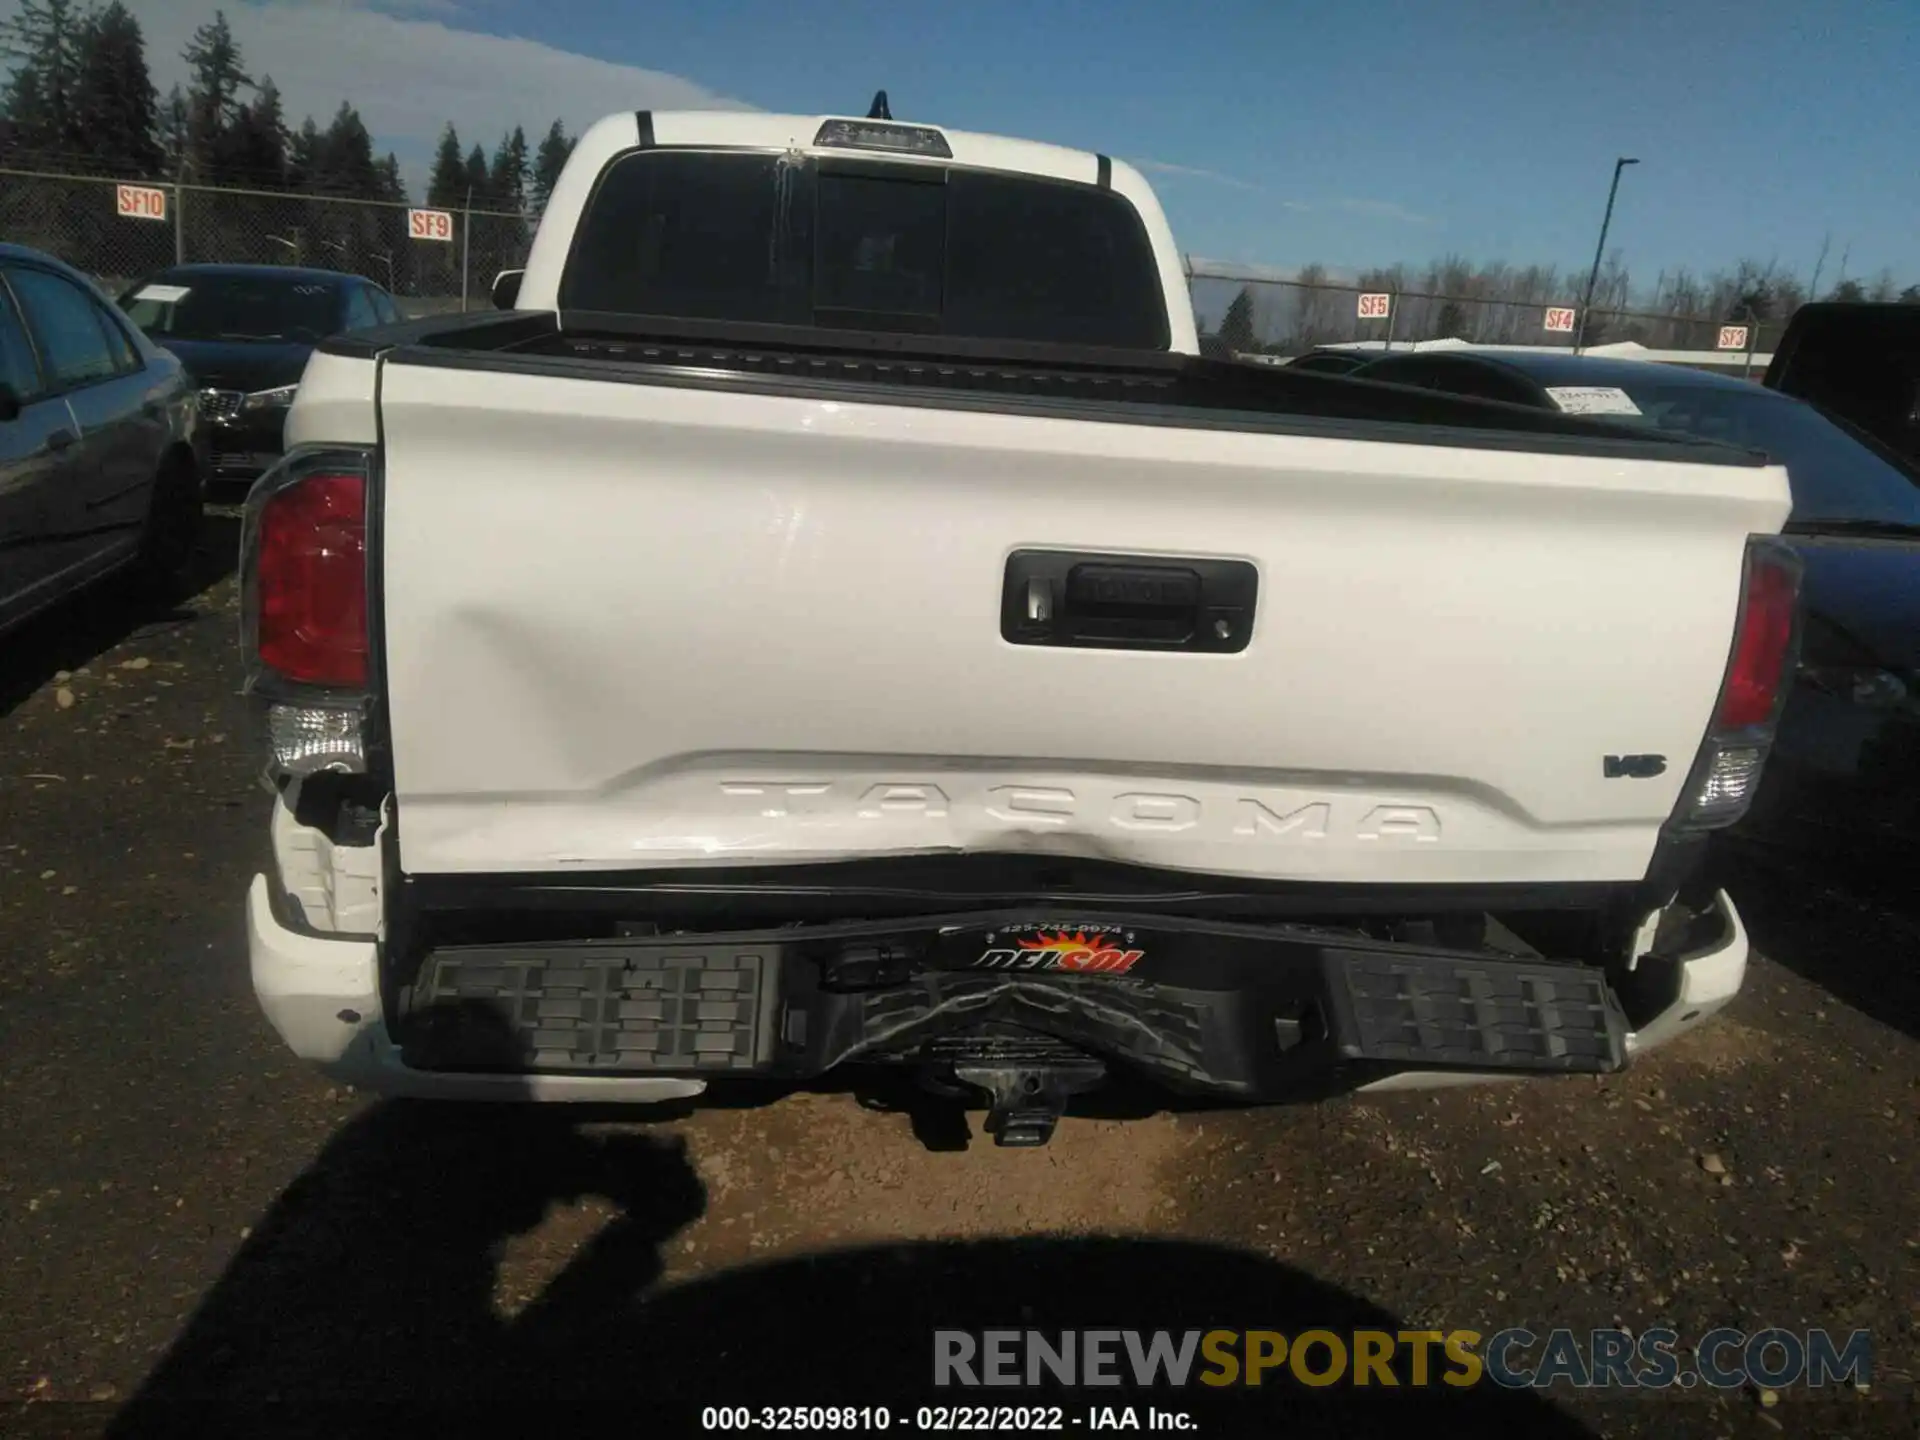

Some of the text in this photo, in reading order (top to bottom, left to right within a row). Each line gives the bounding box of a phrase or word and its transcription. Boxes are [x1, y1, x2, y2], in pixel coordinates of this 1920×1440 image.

[119, 187, 164, 217] SF10
[412, 211, 450, 237] SF9
[1360, 295, 1387, 315] SF5
[1547, 309, 1573, 329] SF4
[1721, 328, 1745, 346] SF3
[719, 780, 1442, 842] TACOMA
